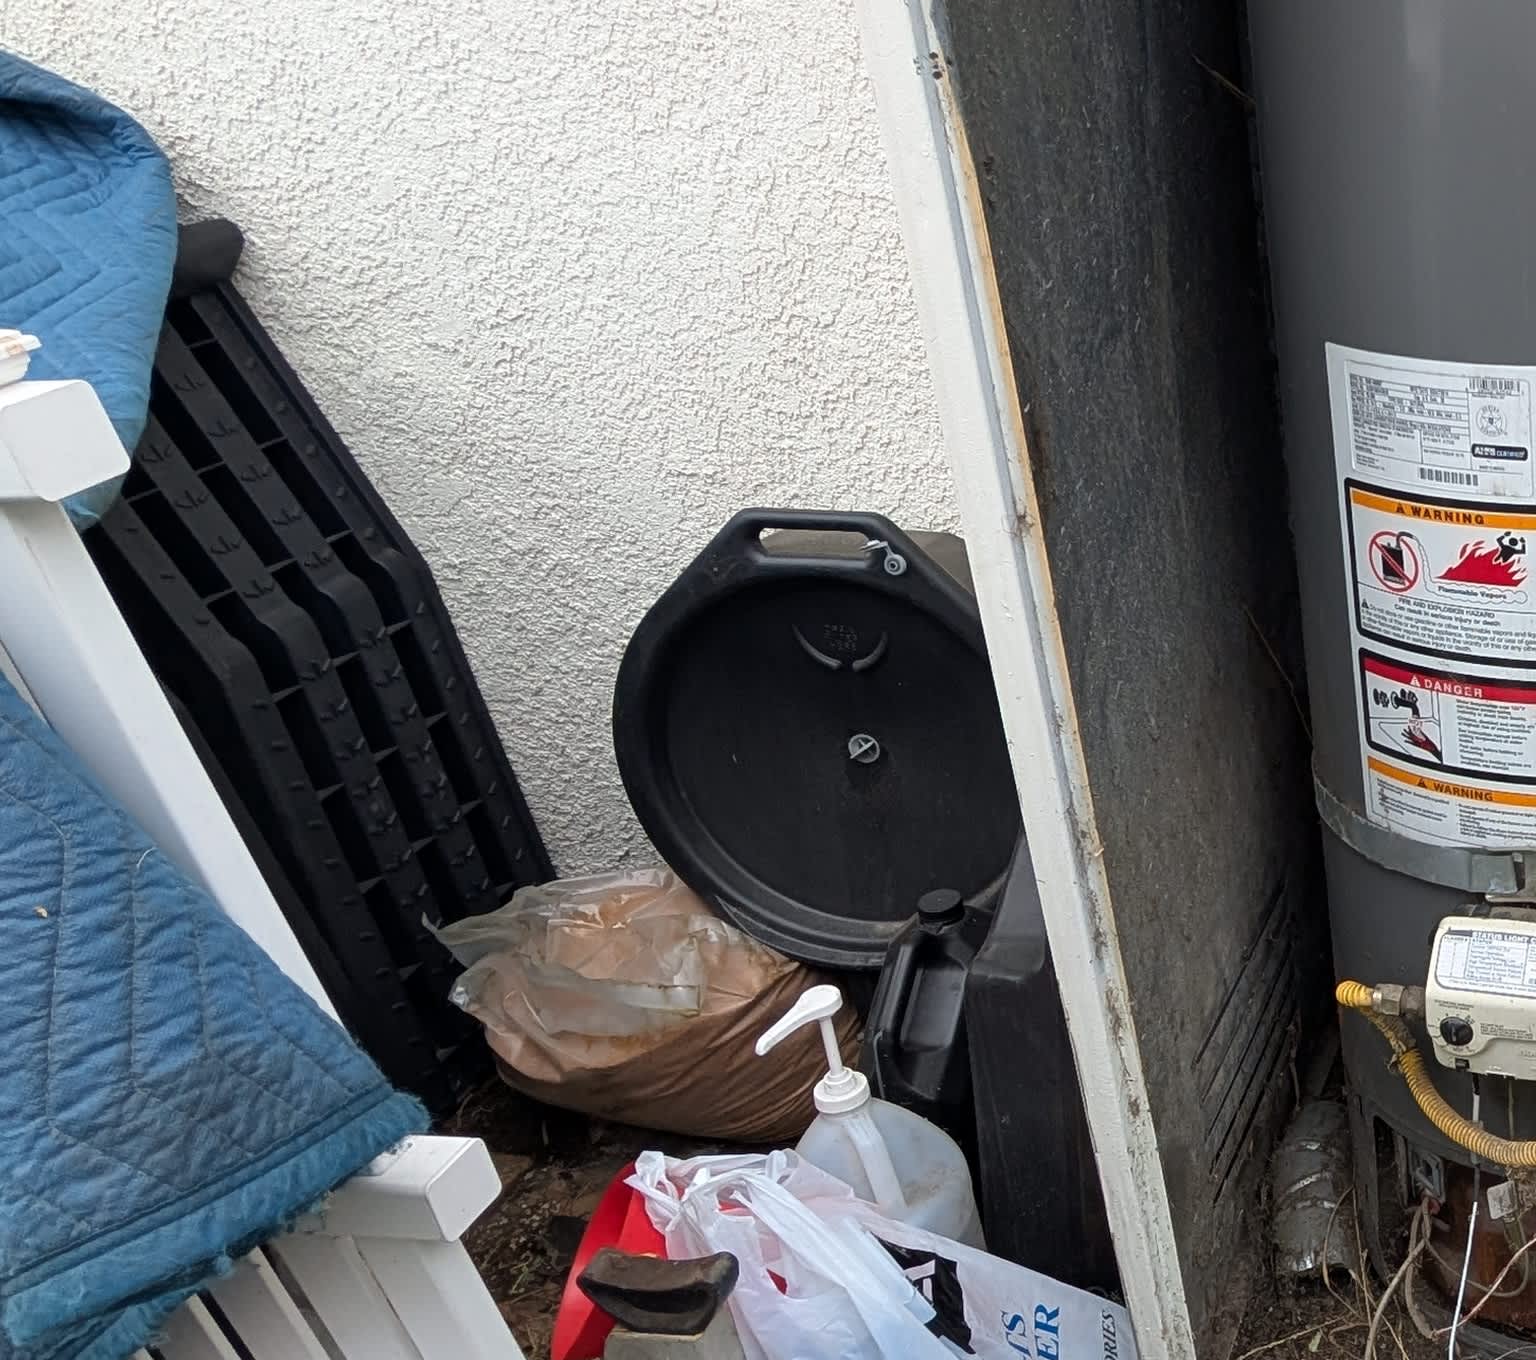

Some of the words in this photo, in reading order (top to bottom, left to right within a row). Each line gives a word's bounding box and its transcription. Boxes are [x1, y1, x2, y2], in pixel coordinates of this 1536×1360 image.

[1411, 507, 1486, 525] WARNING
[1424, 679, 1483, 698] DANGER
[1433, 782, 1494, 801] WARNING
[1504, 934, 1529, 943] LIGHT
